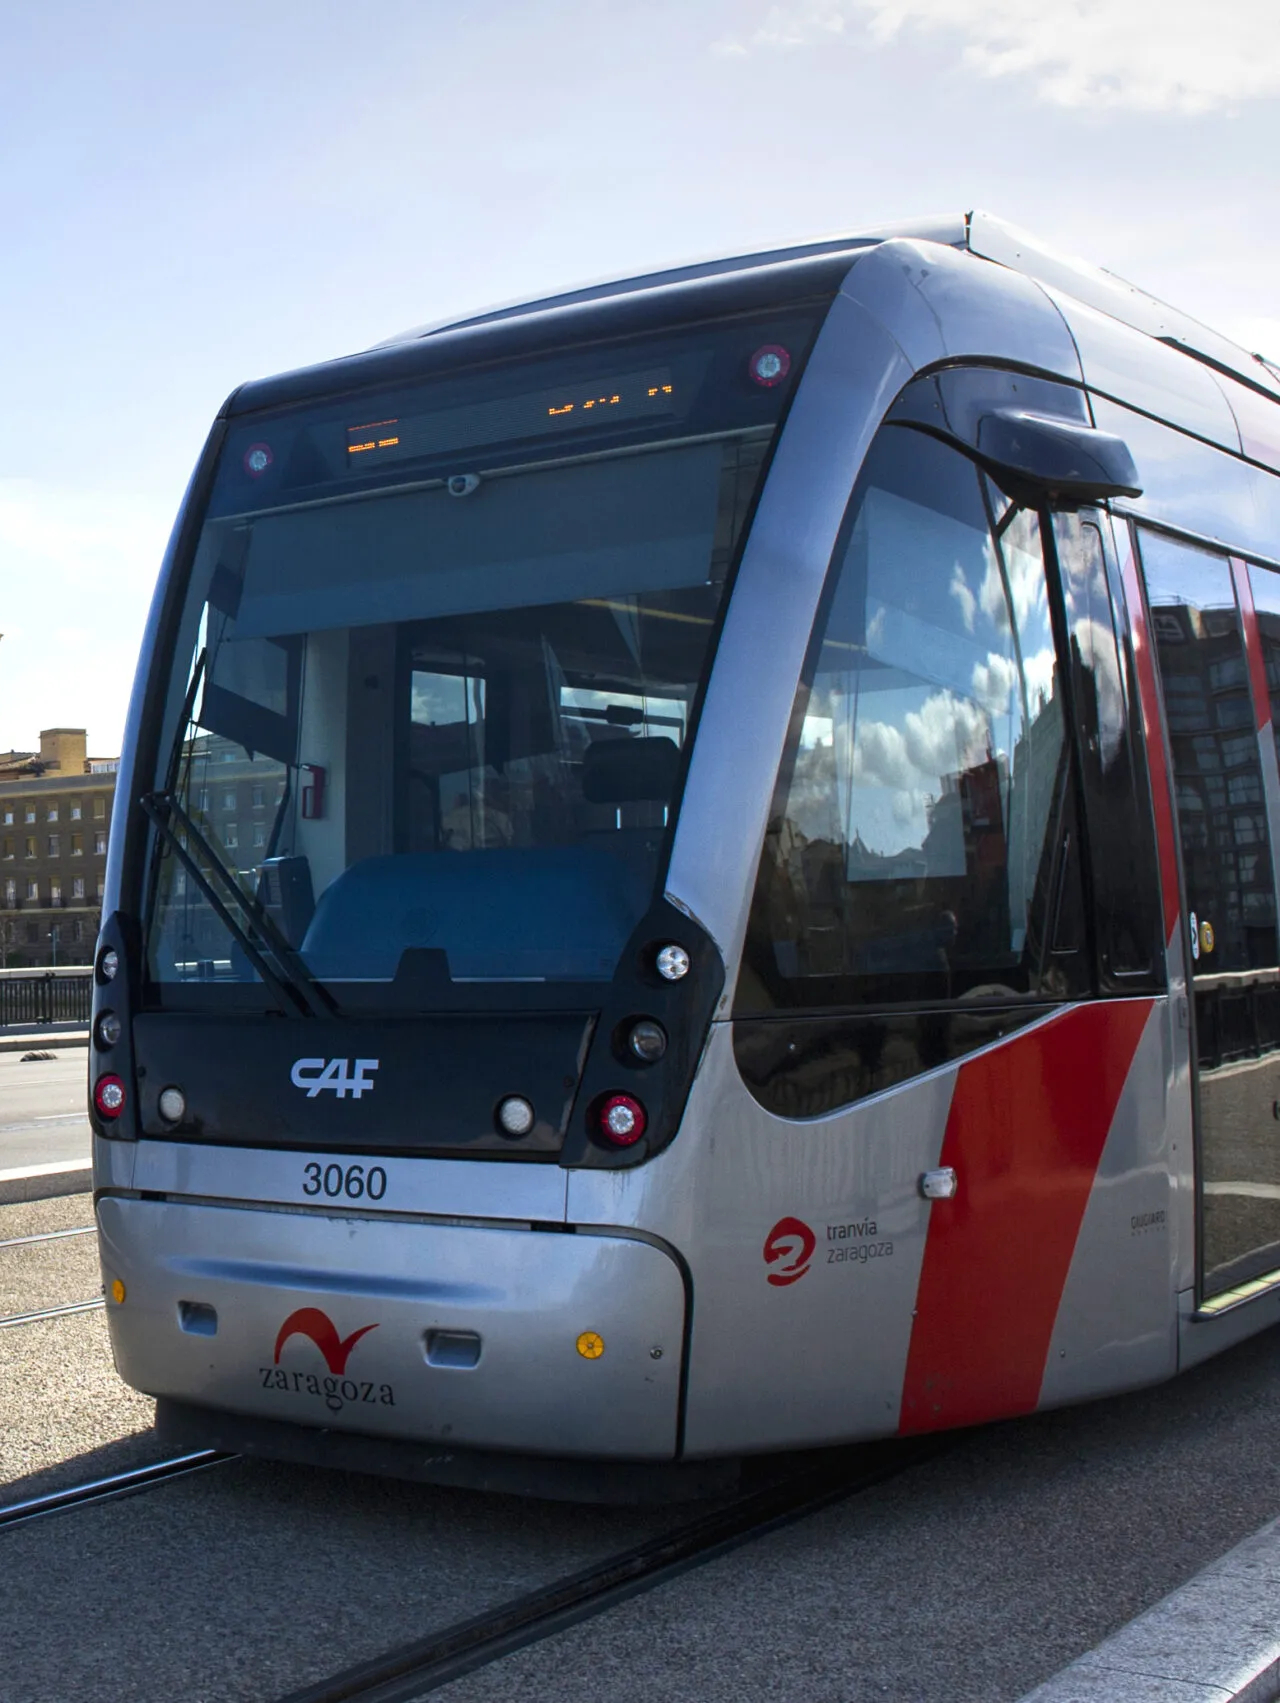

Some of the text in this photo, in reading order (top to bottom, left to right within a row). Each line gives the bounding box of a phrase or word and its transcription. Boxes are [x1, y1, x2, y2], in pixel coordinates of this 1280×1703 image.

[290, 1058, 379, 1098] CAF
[302, 1162, 387, 1200] 3060
[826, 1216, 877, 1240] tranvía
[826, 1241, 894, 1264] zaragoza
[259, 1367, 396, 1411] zaragoza
